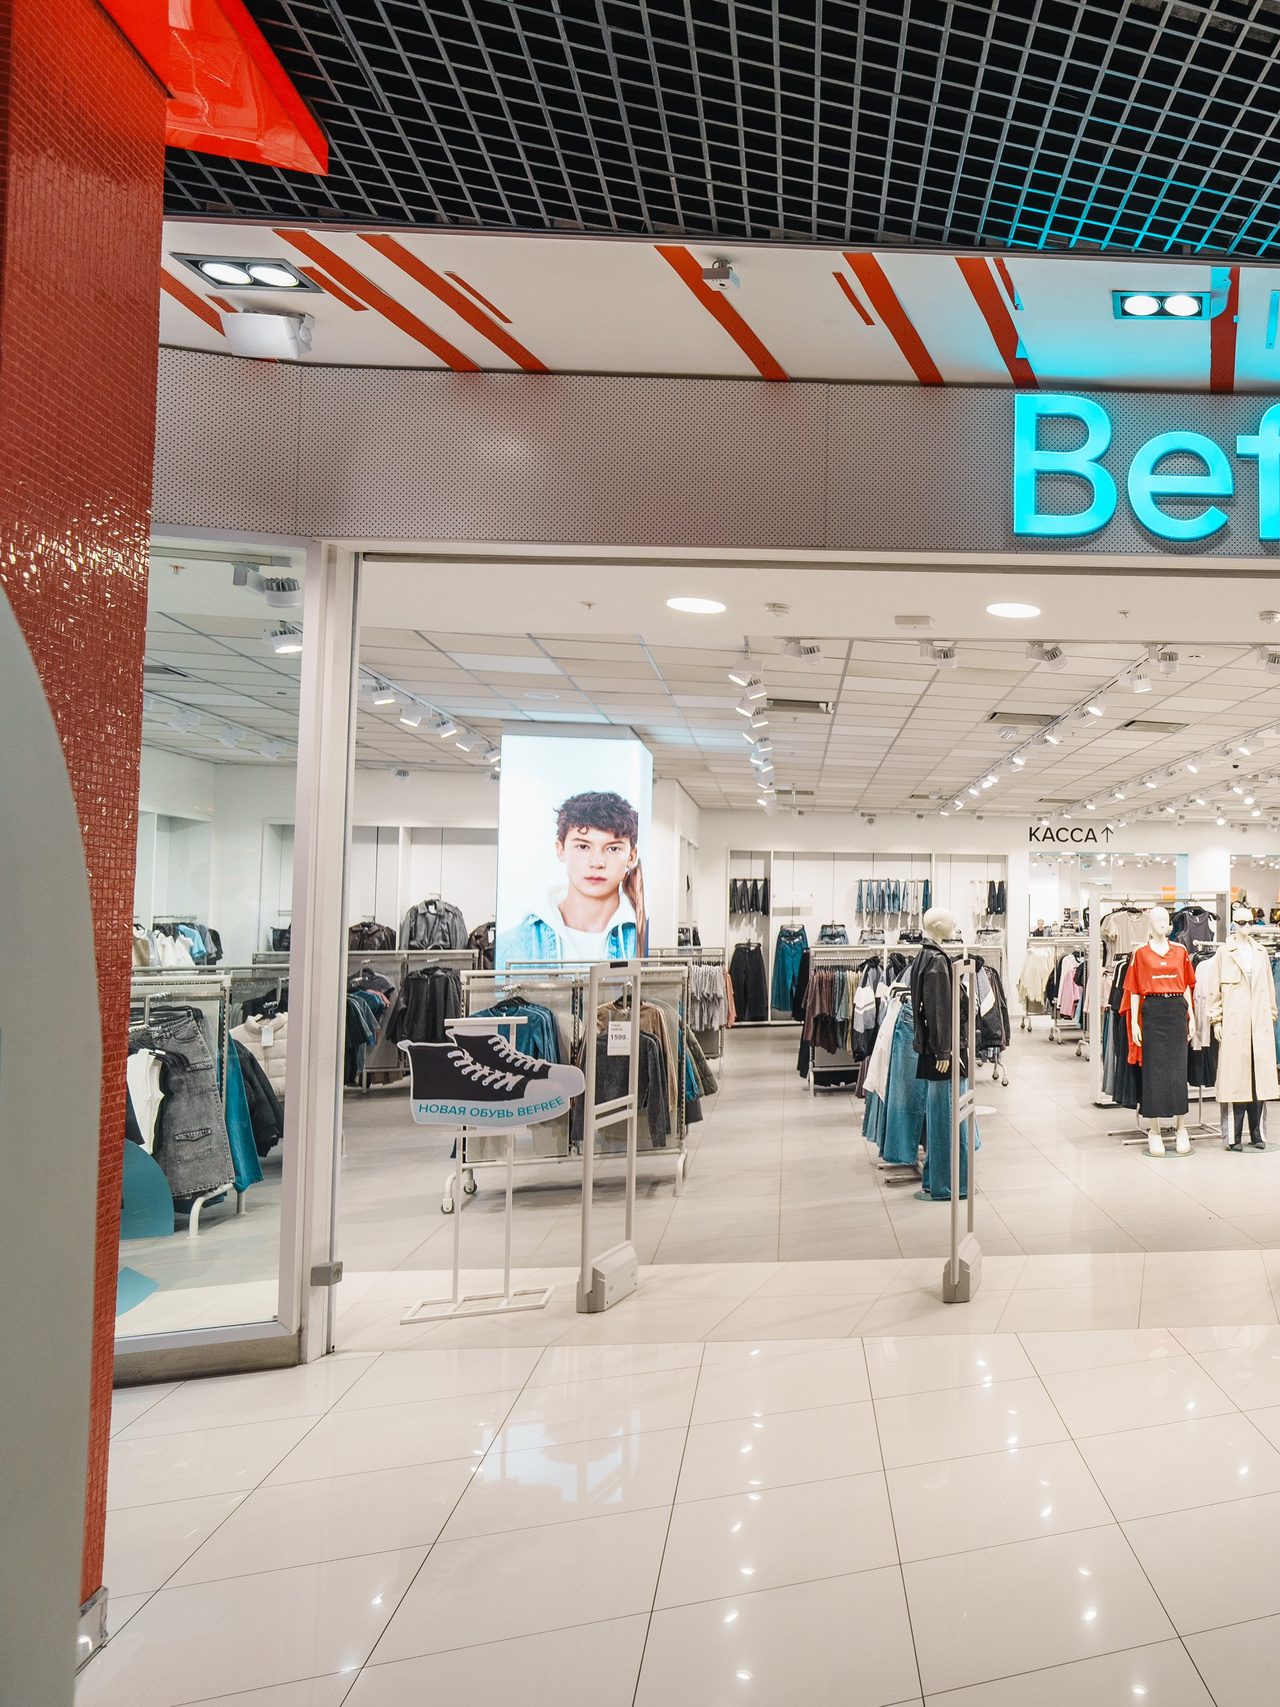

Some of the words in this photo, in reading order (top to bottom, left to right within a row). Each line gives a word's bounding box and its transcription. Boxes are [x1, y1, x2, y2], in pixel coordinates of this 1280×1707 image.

[1029, 826, 1098, 843] КАССА
[418, 1103, 466, 1116] НОВАЯ
[470, 1107, 514, 1119] ОБУВЬ
[517, 1095, 565, 1117] BEFREE
